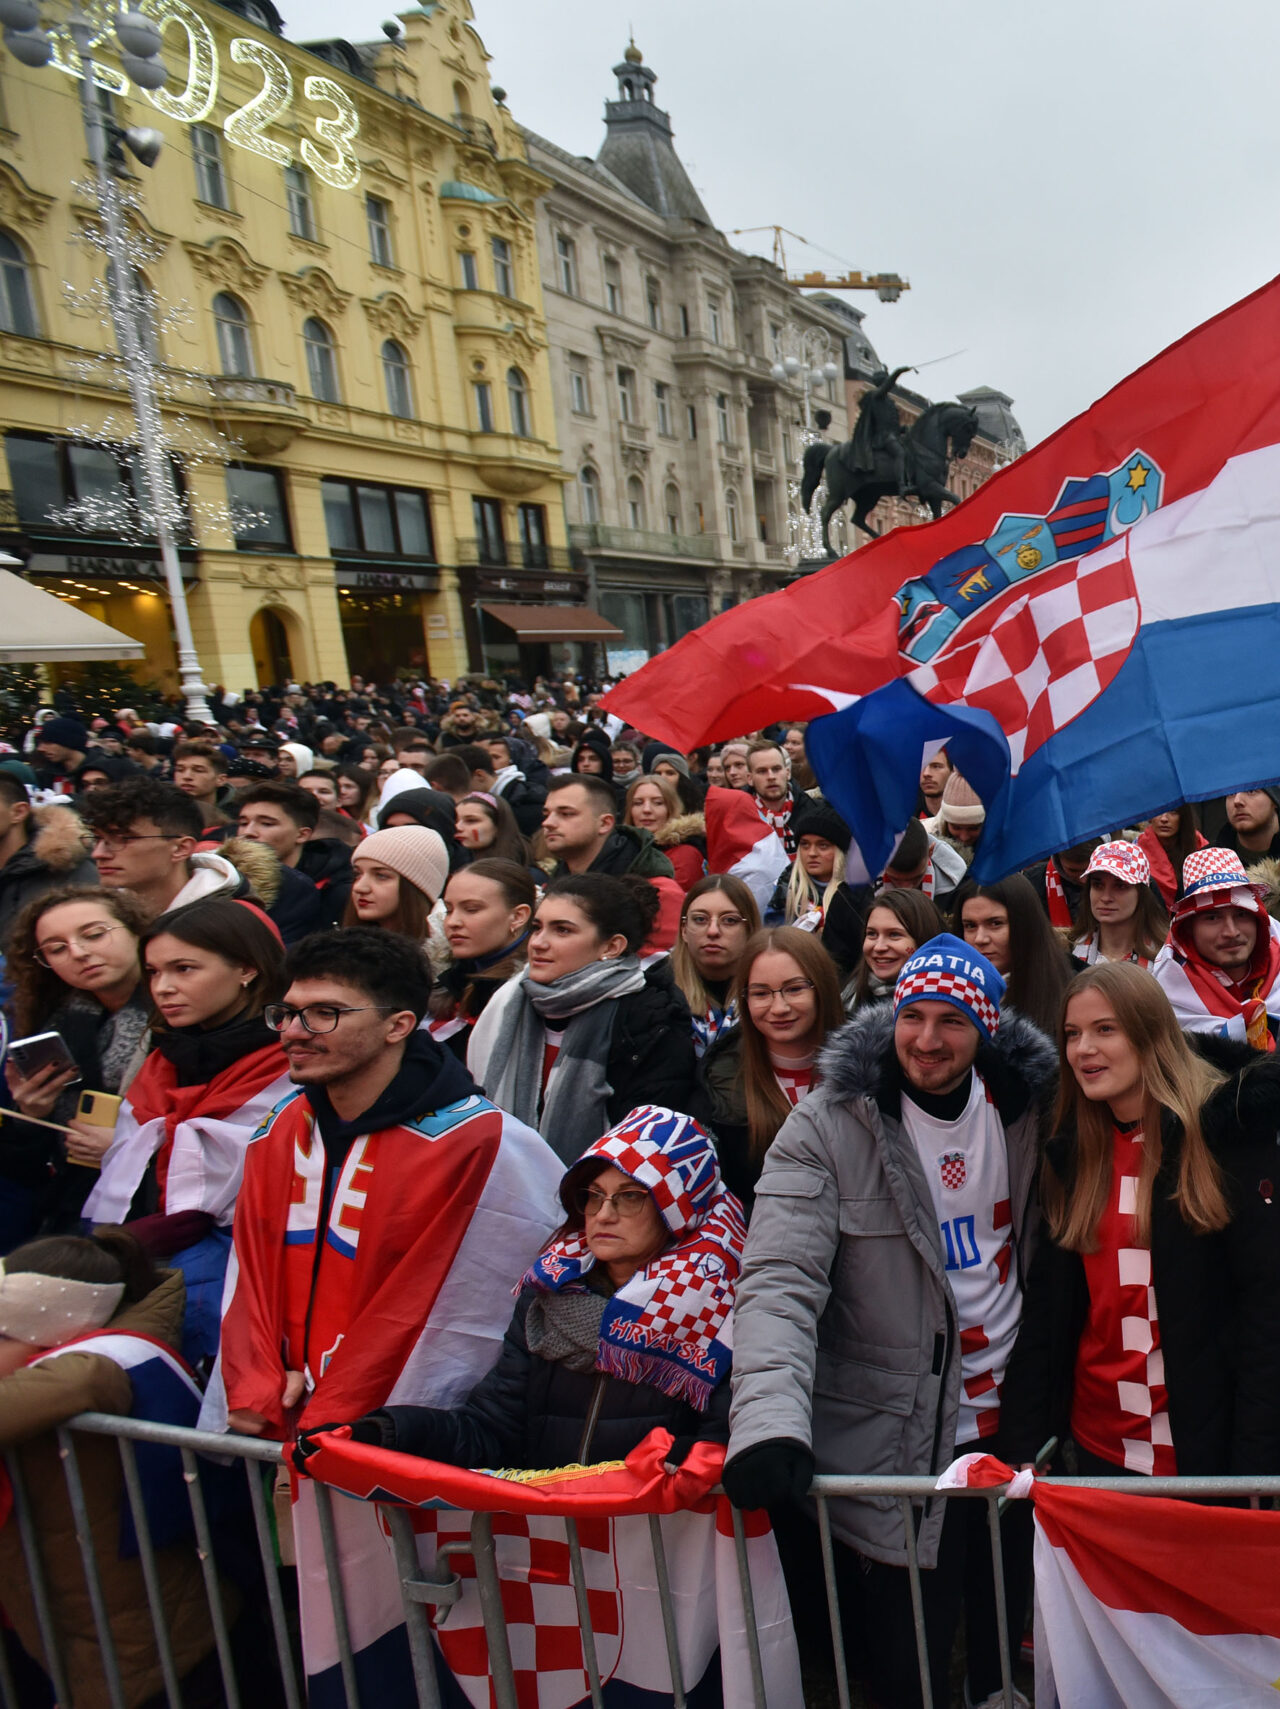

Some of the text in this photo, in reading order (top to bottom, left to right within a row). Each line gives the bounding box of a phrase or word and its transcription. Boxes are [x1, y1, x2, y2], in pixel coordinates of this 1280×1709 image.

[900, 954, 985, 986] ROATIA
[941, 1214, 982, 1271] 10
[609, 1316, 718, 1378] HRVATSKA
